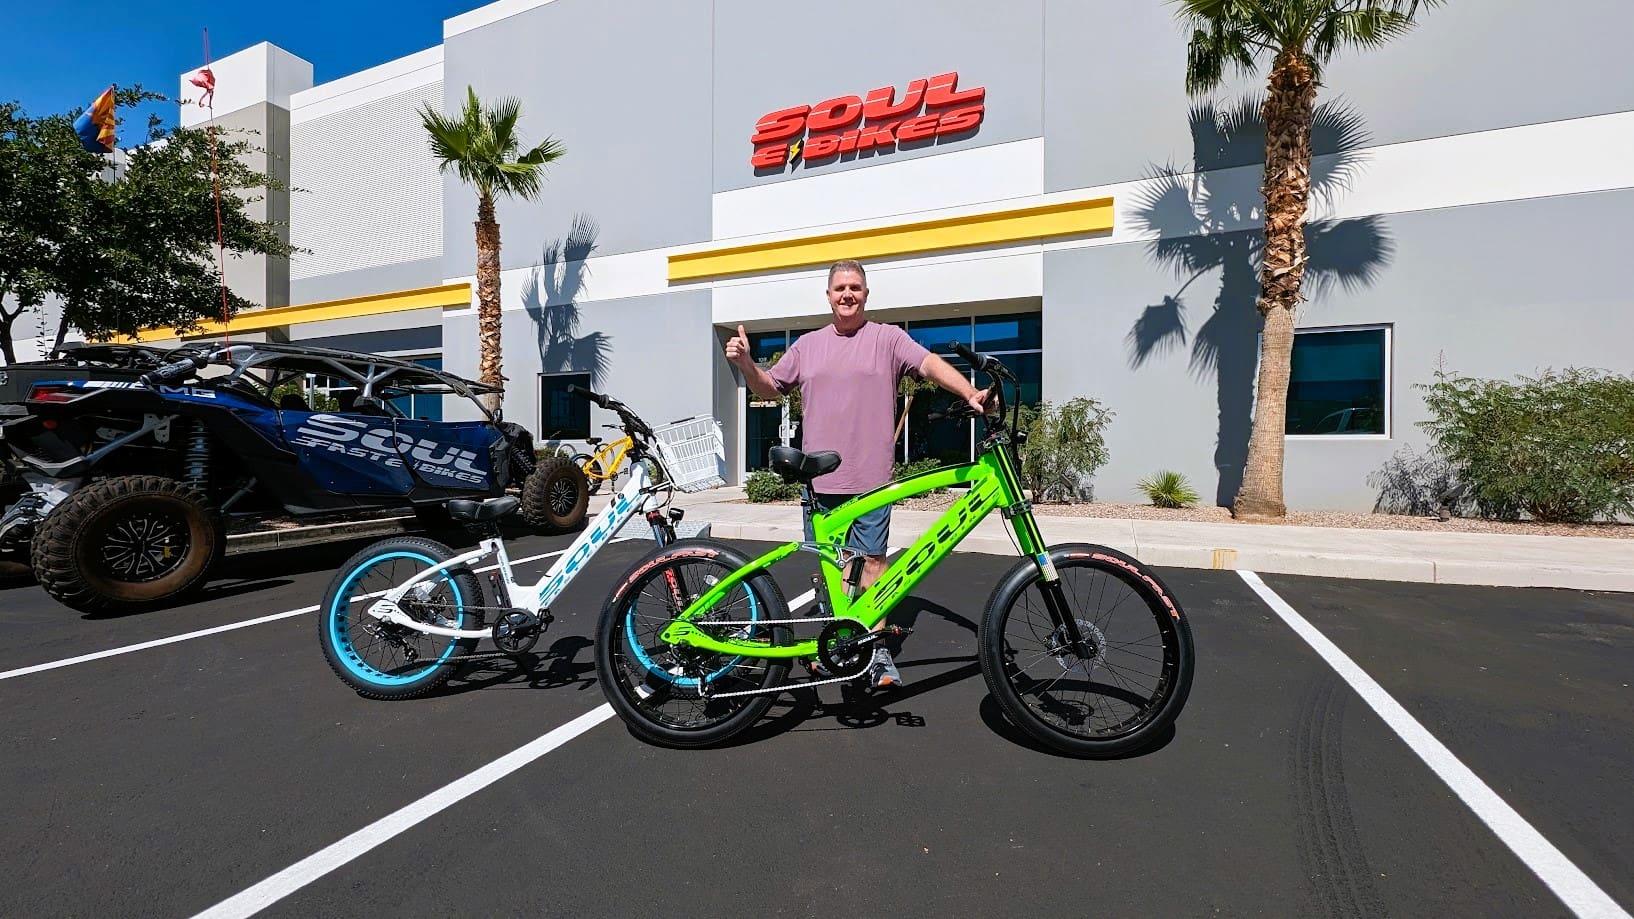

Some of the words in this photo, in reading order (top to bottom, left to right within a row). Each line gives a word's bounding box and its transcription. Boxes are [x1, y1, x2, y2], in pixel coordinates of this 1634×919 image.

[751, 71, 986, 144] SOUL
[802, 104, 986, 161] BIKES
[291, 436, 388, 462] FAST
[420, 463, 485, 484] BIKES
[297, 414, 488, 476] SOUL
[539, 492, 641, 606] SOUL
[874, 486, 1000, 610] SOUL
